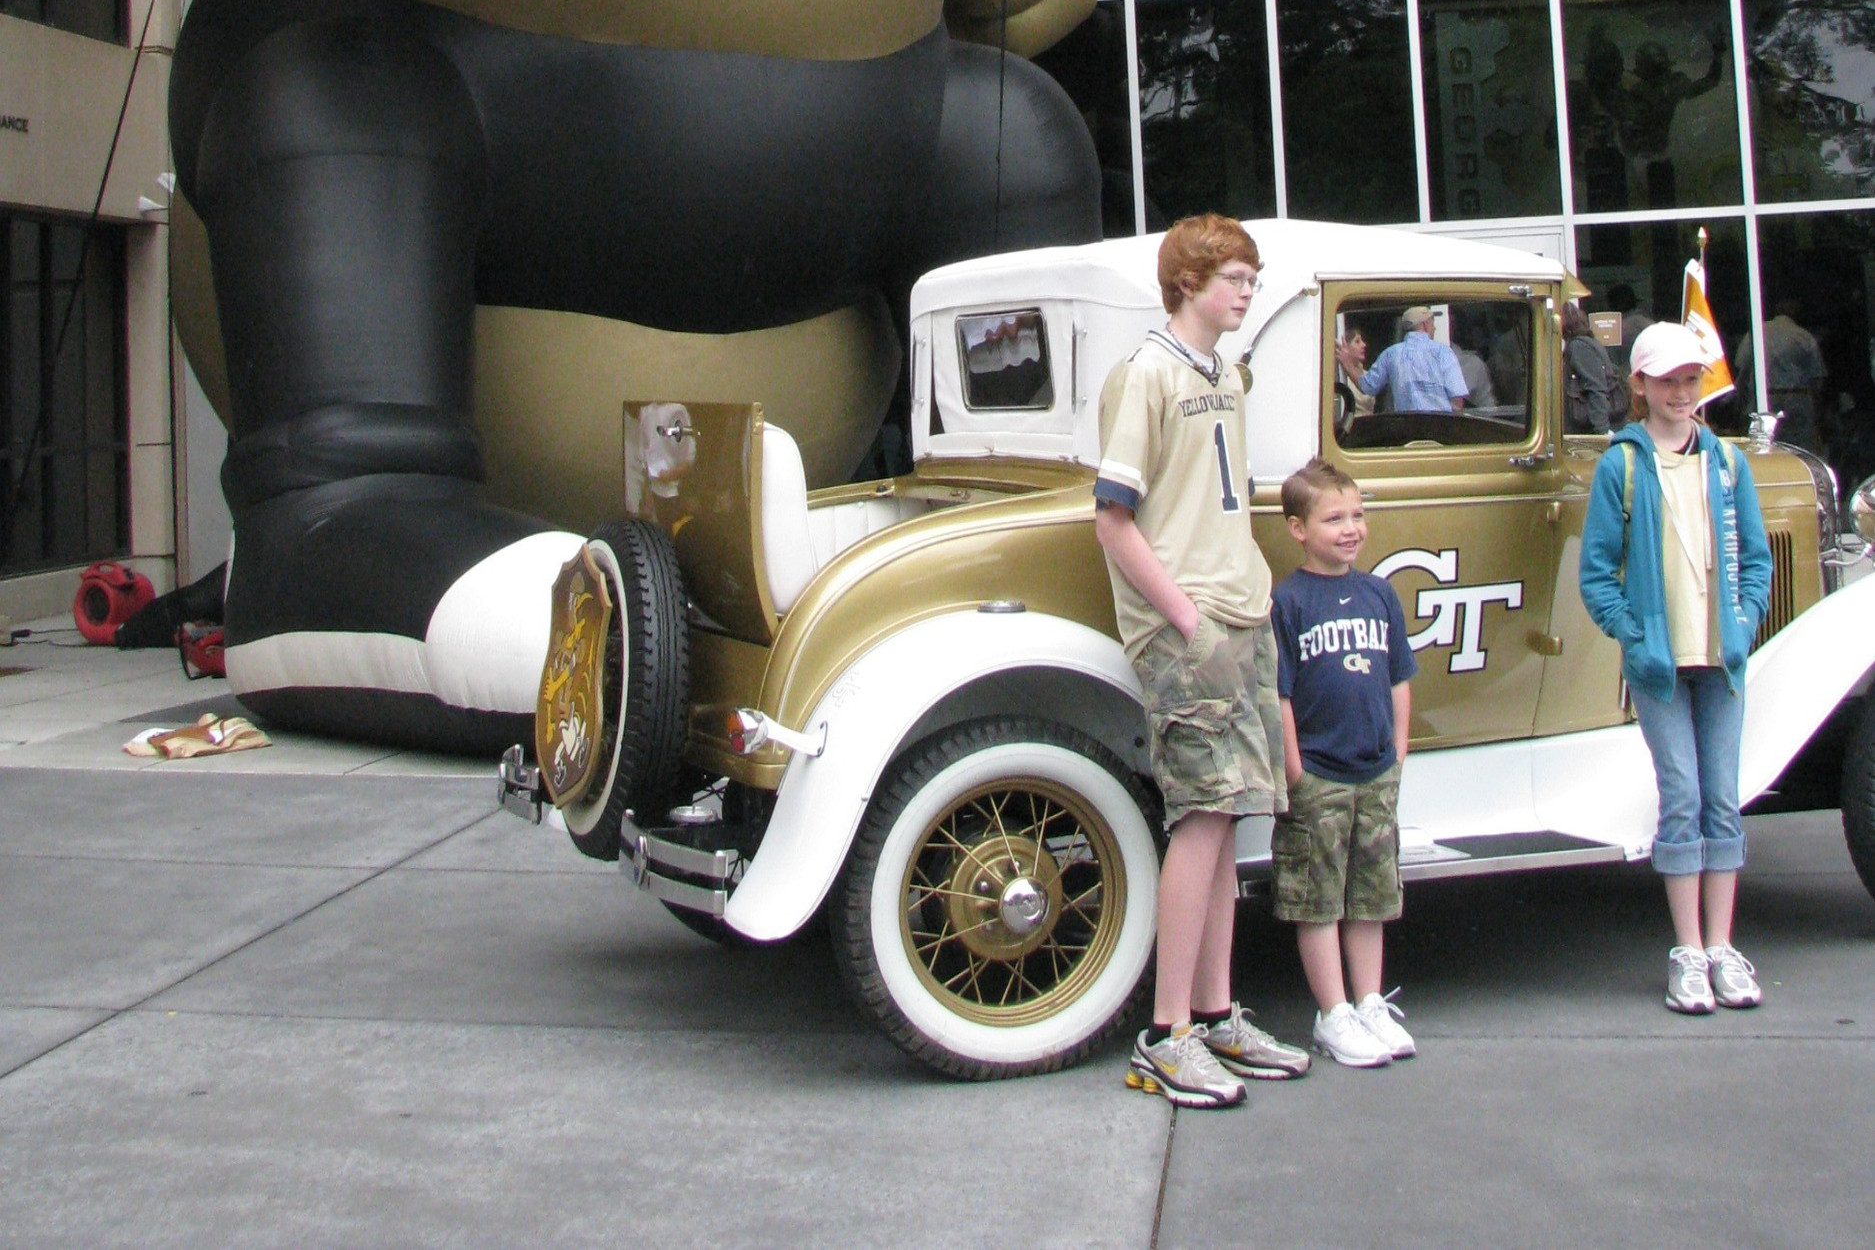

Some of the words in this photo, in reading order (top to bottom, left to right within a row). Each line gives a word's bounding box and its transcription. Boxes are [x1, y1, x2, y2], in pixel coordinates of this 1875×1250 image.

[0, 114, 29, 133] ANCE
[1214, 419, 1242, 515] 1
[1369, 547, 1524, 674] GT
[1343, 652, 1372, 674] GT
